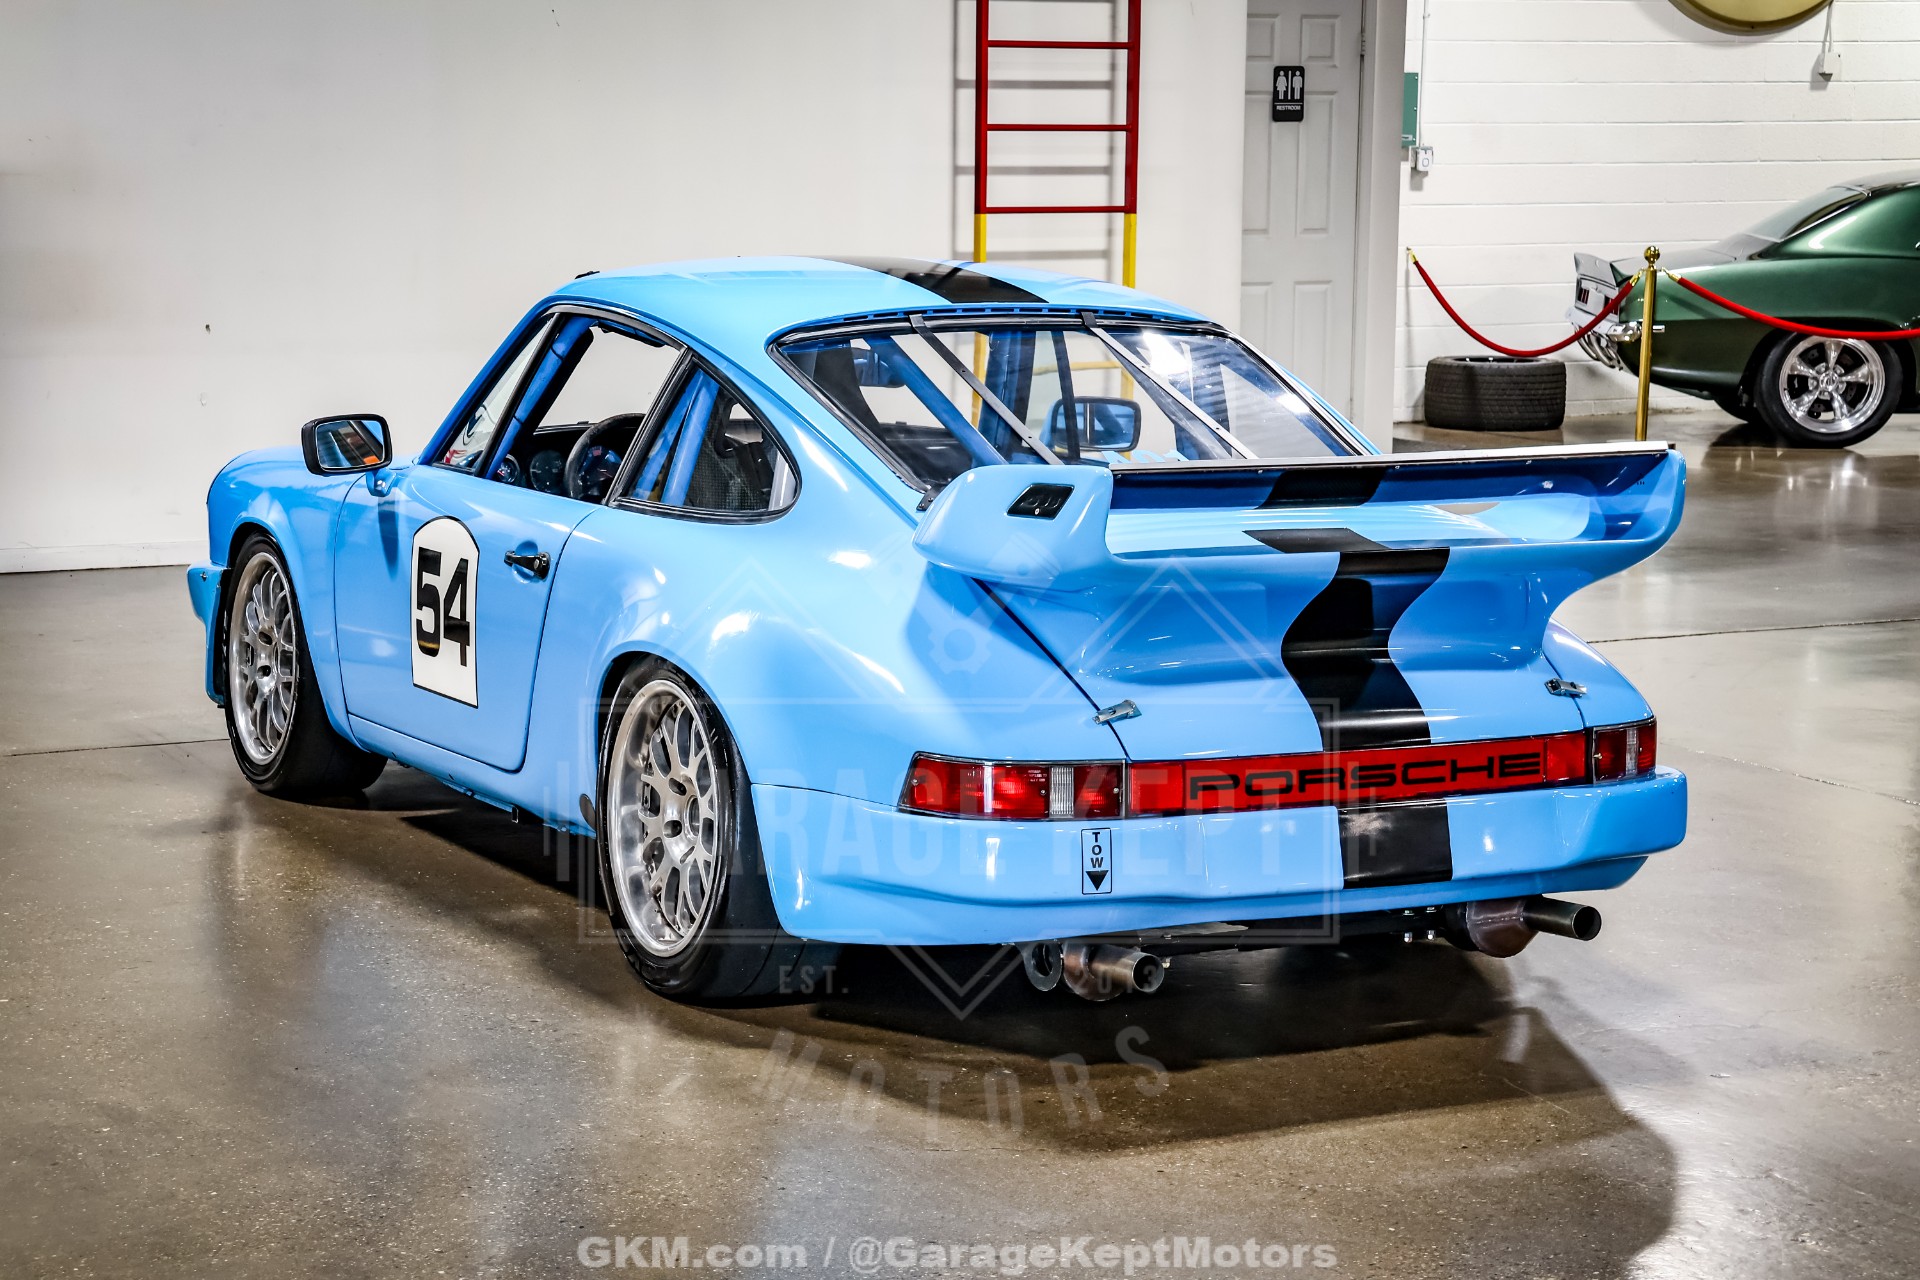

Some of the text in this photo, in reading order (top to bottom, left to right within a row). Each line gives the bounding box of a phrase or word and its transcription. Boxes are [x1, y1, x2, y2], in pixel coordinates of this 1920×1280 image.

[416, 546, 470, 667] 54
[1190, 752, 1541, 800] PORSCHE
[1090, 831, 1104, 868] TOW
